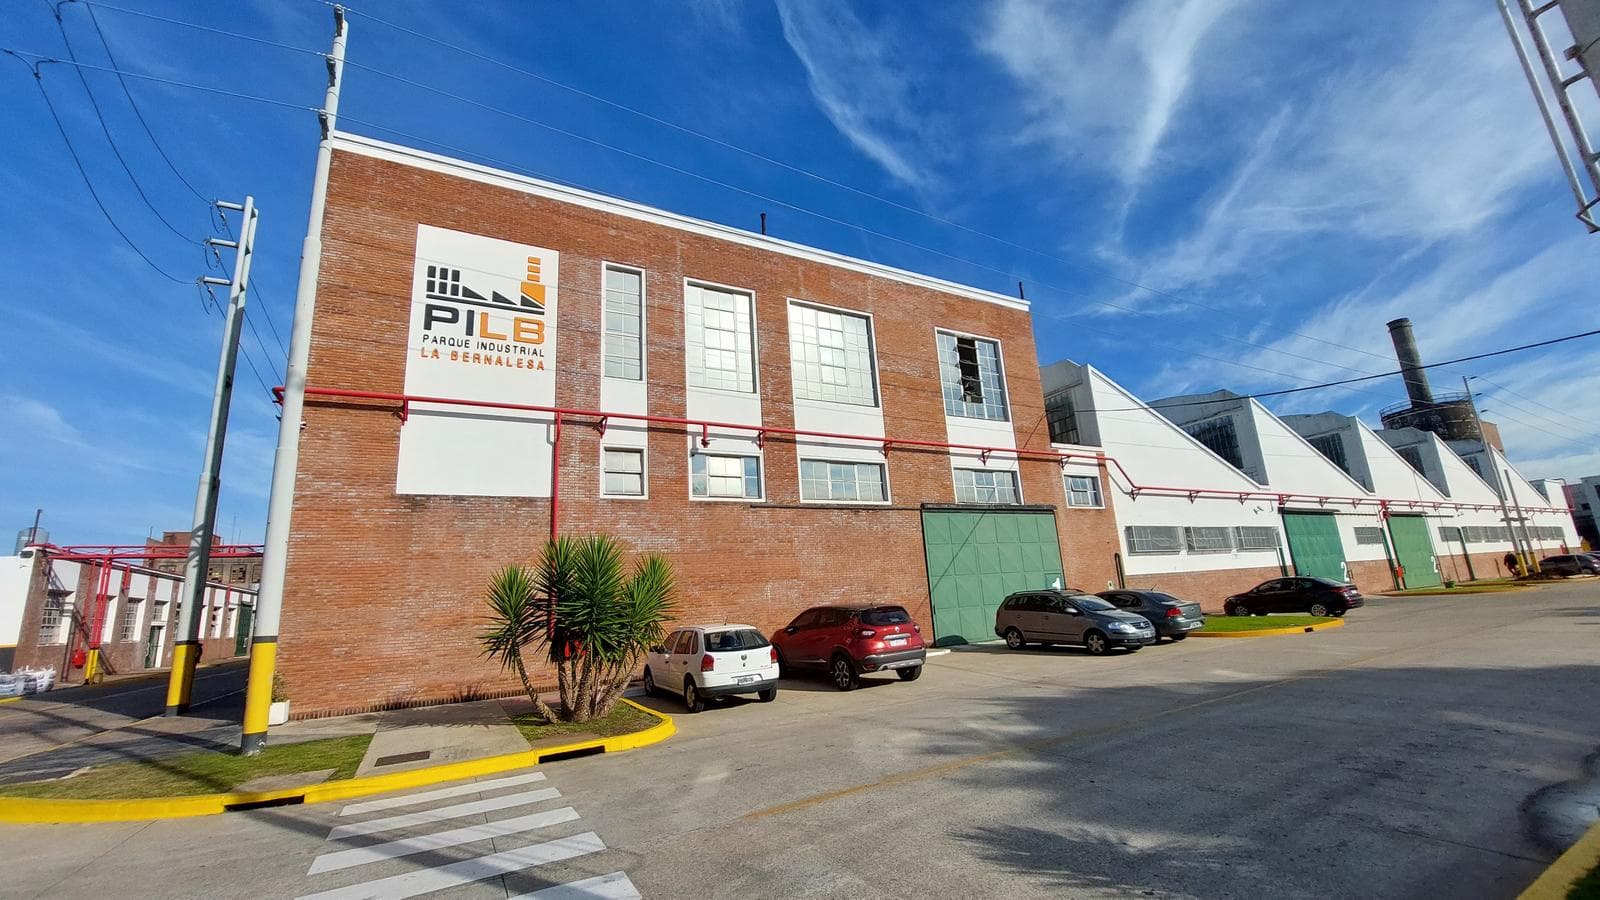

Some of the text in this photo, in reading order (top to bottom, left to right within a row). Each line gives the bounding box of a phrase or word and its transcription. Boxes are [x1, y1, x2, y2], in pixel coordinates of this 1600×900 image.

[423, 304, 545, 345] PILB
[422, 334, 545, 357] PARQUE INDUSTRIAL
[421, 347, 545, 371] LA BERNALESA
[1340, 561, 1350, 581] 2
